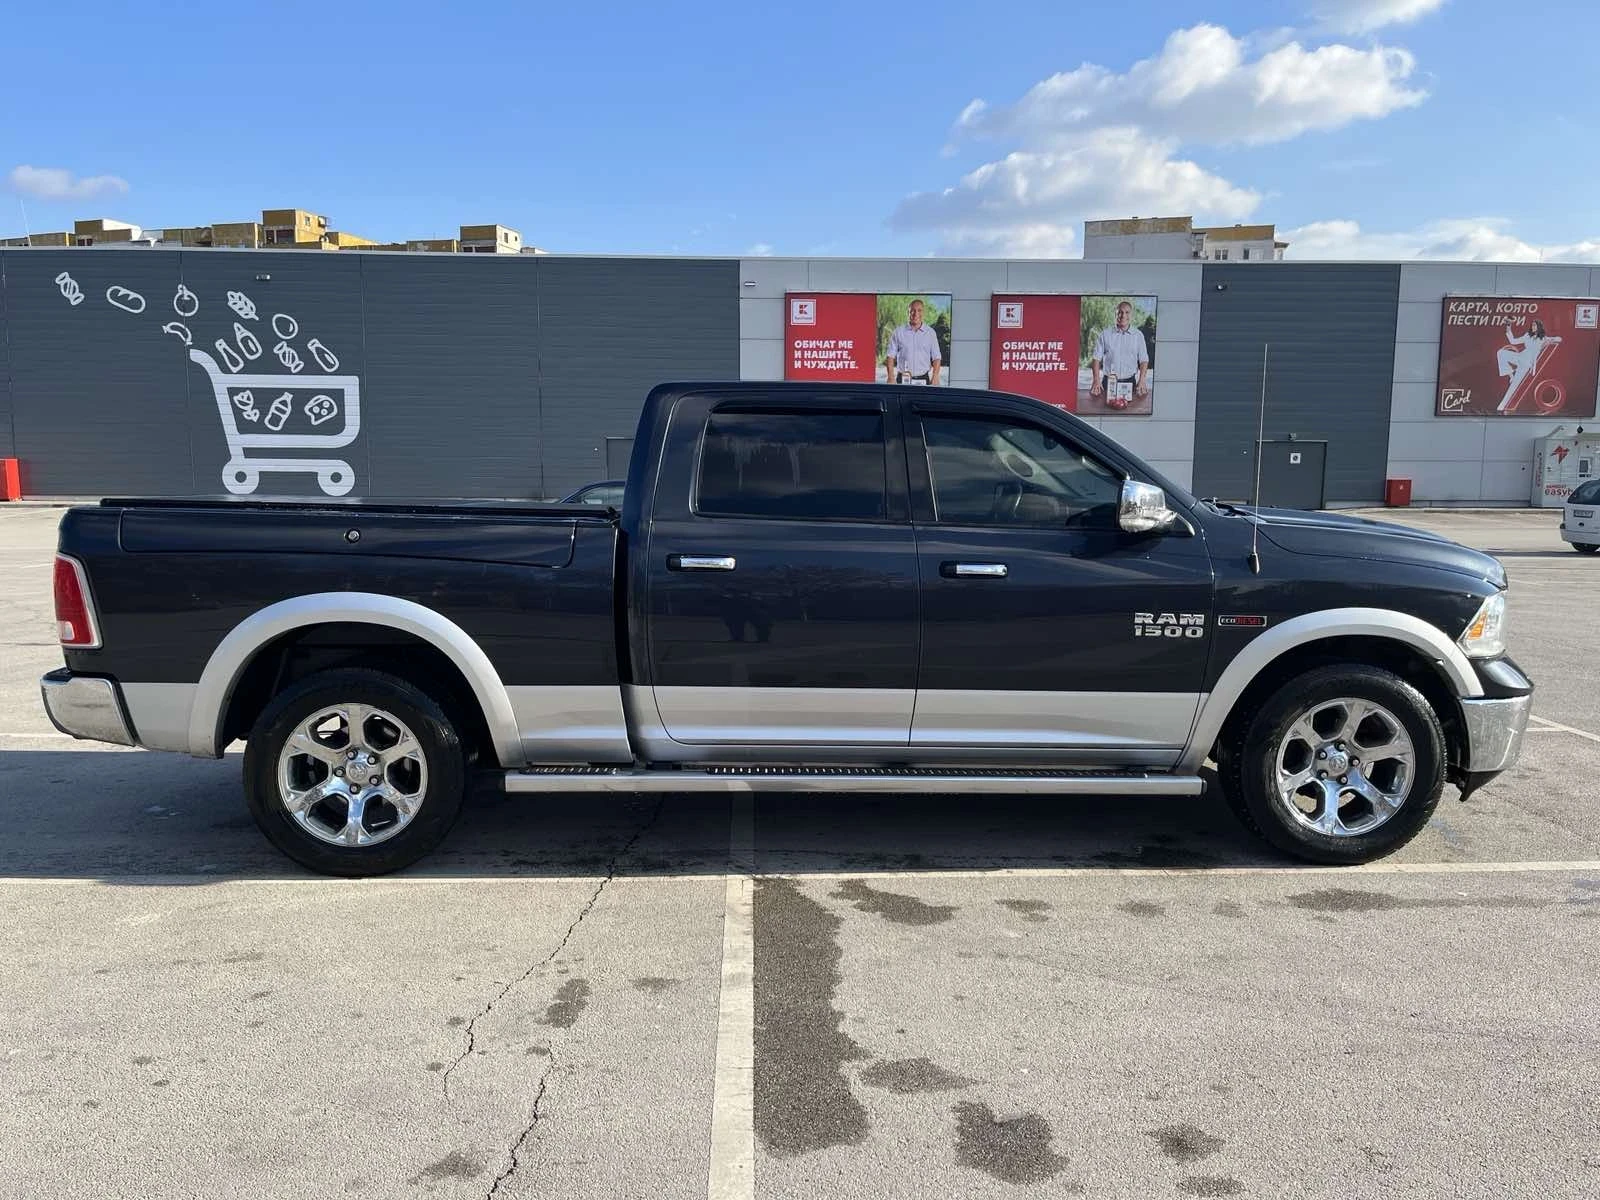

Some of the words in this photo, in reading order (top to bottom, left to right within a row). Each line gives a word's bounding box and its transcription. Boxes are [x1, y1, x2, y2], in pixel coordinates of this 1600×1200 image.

[1448, 302, 1492, 314] КАРТА,
[1496, 302, 1538, 313] КОЯТО
[1448, 314, 1489, 326] ПЕСТИ
[794, 340, 835, 349] ОБИЧАТ
[838, 340, 853, 349] МЕ
[1003, 341, 1044, 350] ОБИЧАТ
[1048, 341, 1063, 350] МЕ
[794, 350, 801, 359] И
[804, 350, 851, 360] НАШИТЕ,
[1002, 351, 1009, 360] И
[1012, 351, 1061, 361] НАШИТЕ,
[794, 360, 801, 369] И
[804, 360, 859, 370] ЧУЖДИТЕ.
[1002, 362, 1009, 371] И
[1011, 362, 1068, 372] ЧУЖДИТЕ.
[1444, 389, 1471, 409] Card
[1134, 612, 1205, 625] RAM
[1134, 625, 1204, 638] 1500
